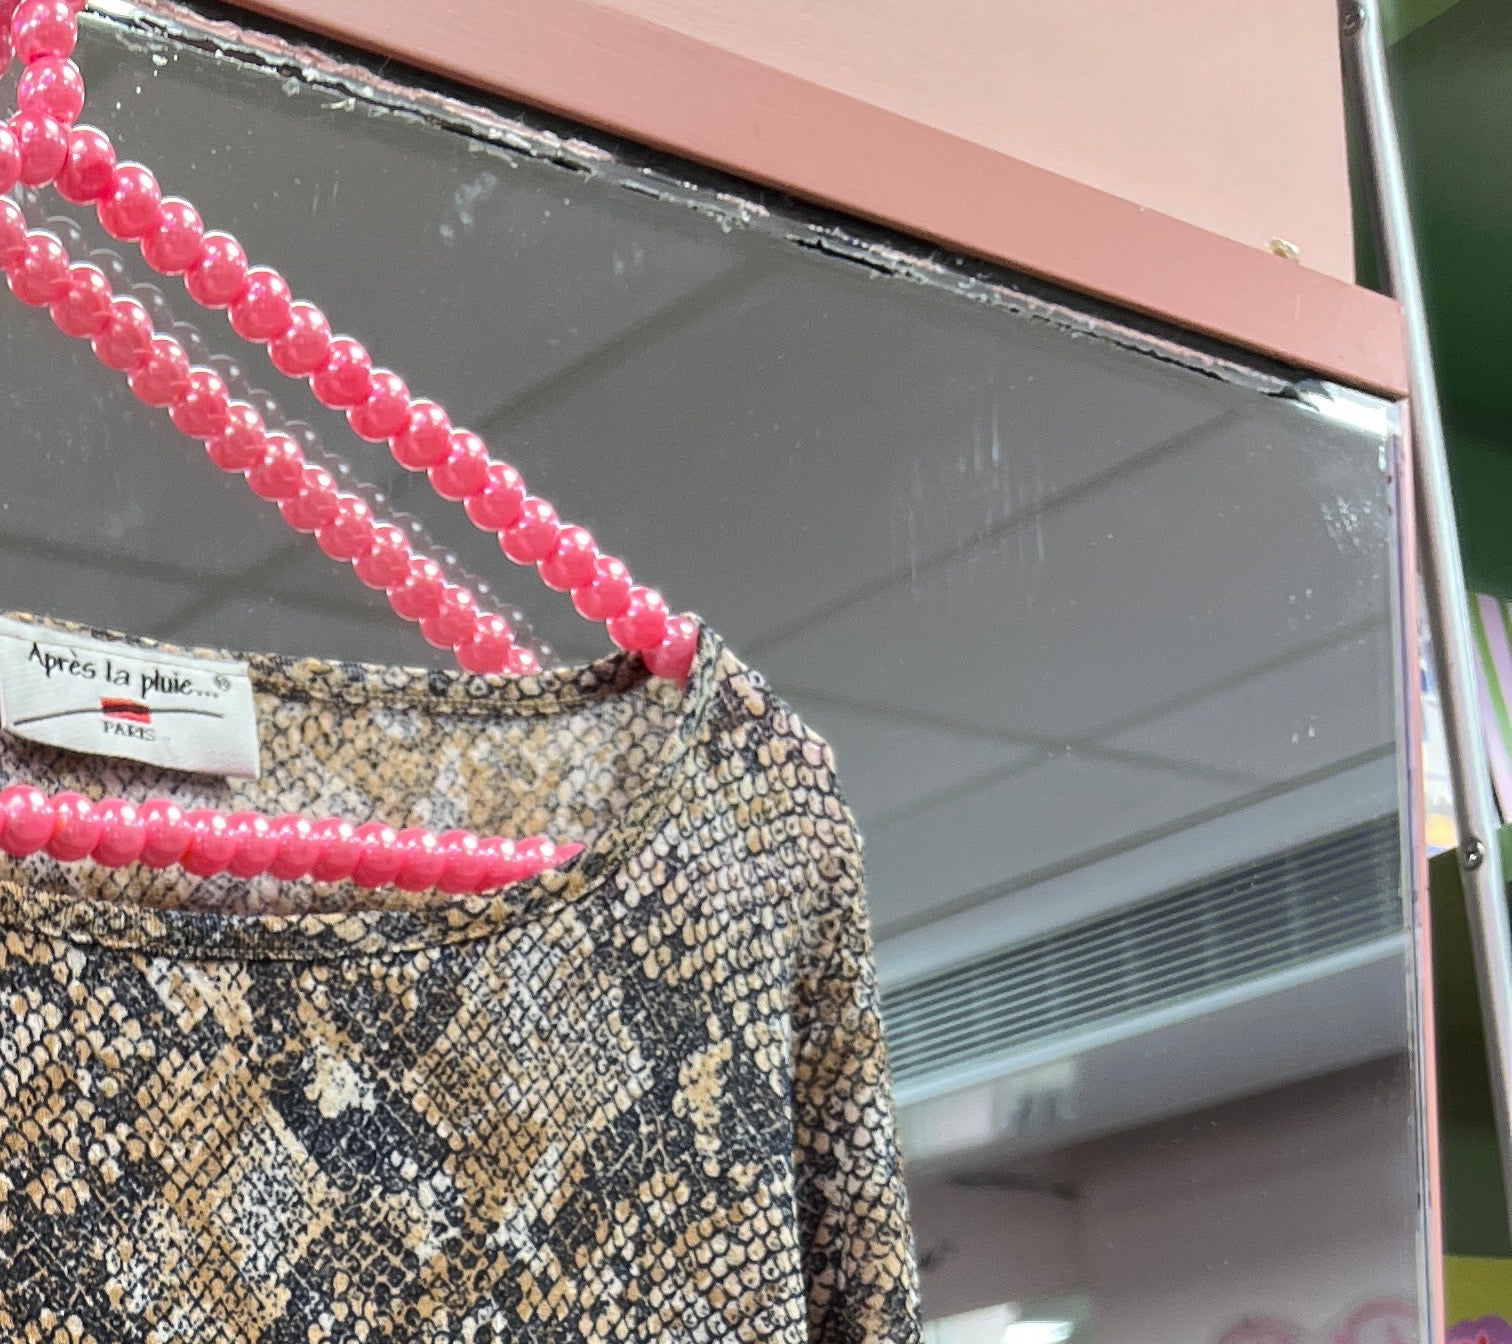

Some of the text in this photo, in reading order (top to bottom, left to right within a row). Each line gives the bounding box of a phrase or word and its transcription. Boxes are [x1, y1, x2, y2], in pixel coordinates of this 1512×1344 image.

[28, 641, 96, 678] Après
[106, 659, 130, 686] la
[101, 719, 157, 742] PARIS
